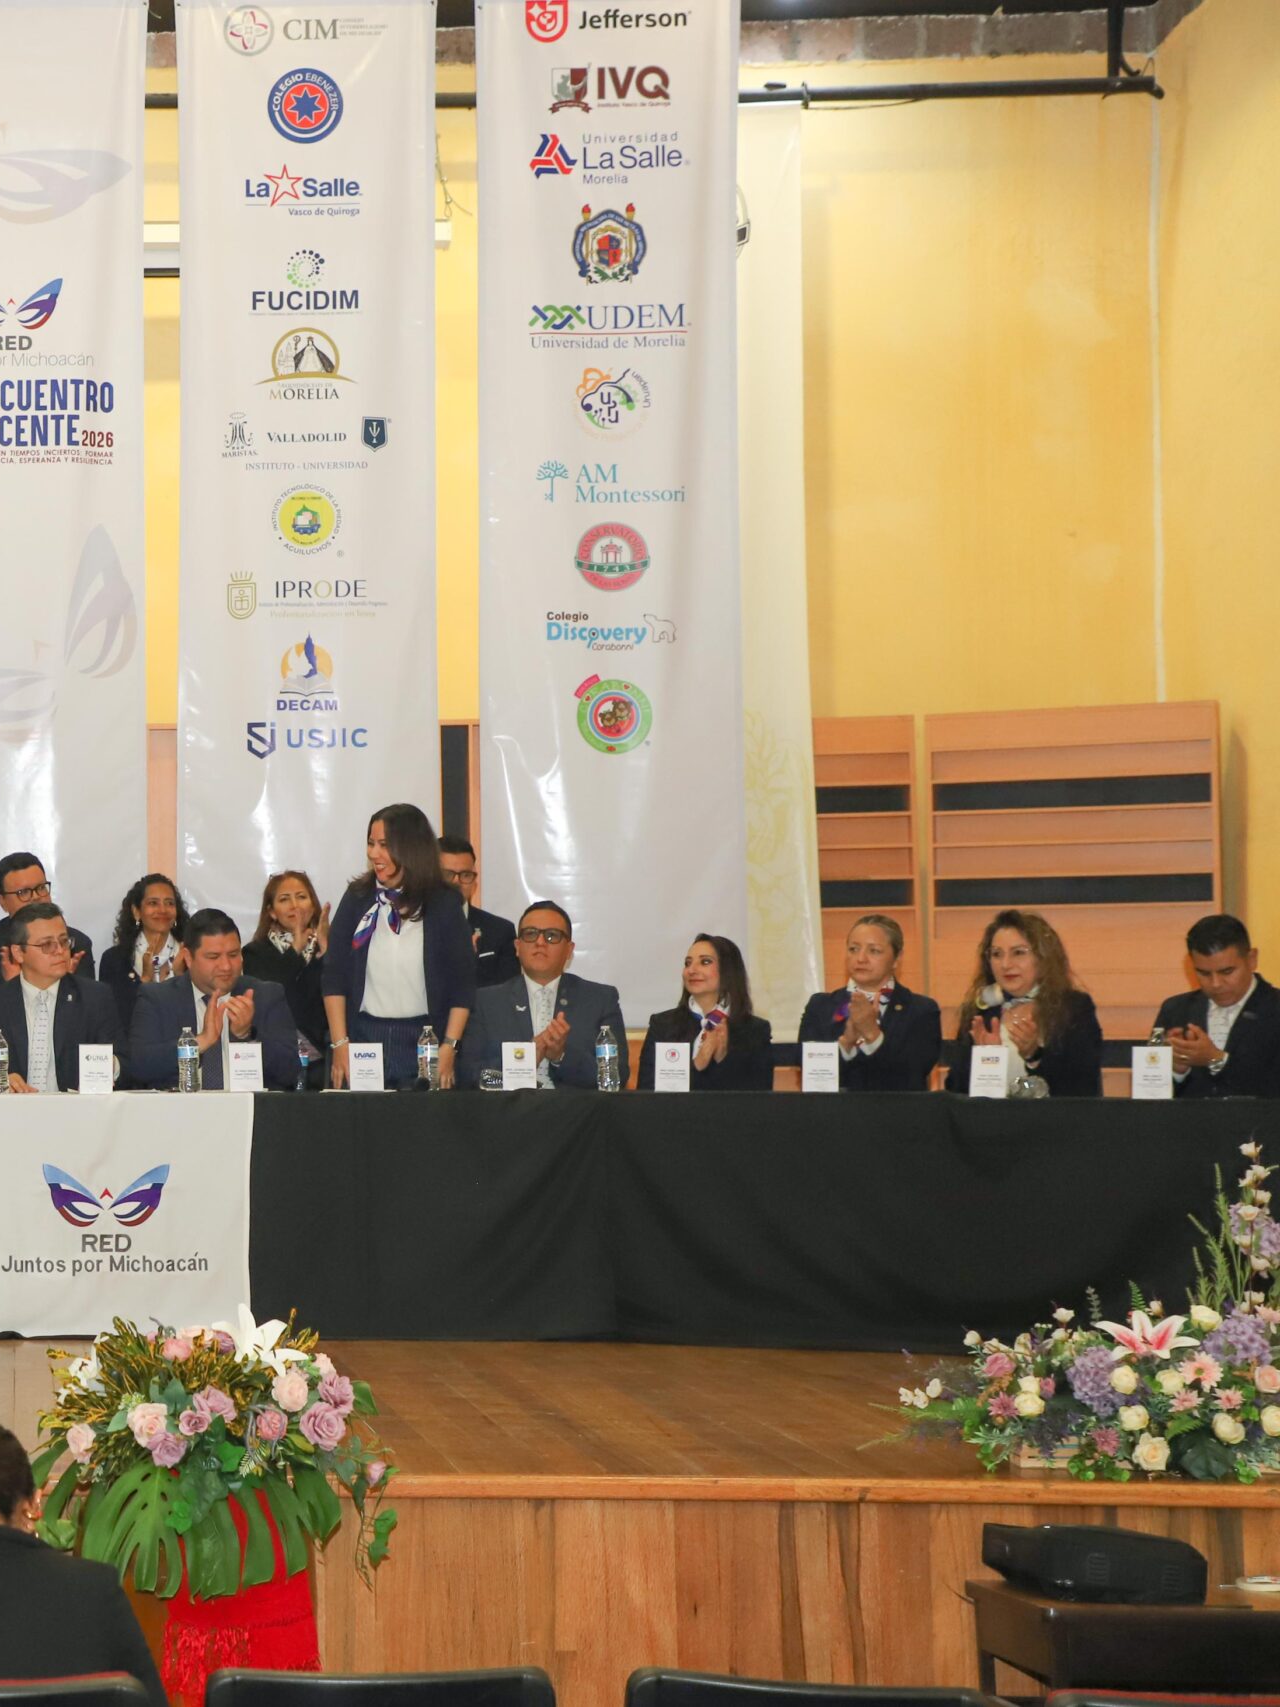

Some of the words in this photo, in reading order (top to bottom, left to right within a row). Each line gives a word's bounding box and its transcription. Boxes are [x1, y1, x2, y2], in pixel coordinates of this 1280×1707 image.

[578, 9, 687, 29] Jefferson
[282, 18, 339, 41] CIM
[272, 73, 304, 111] COLEGIO
[305, 72, 339, 111] EBENEZER
[597, 65, 670, 100] IVQ
[582, 131, 678, 144] Universidad
[245, 178, 270, 198] La
[302, 177, 360, 198] Salle
[582, 174, 628, 184] Morelia
[288, 208, 312, 216] Vasco
[314, 207, 324, 216] de
[326, 207, 360, 217] Quiroga
[252, 289, 359, 311] FUCIDIM
[587, 303, 685, 330] UDEM
[530, 335, 609, 349] Universidad
[613, 336, 629, 348] de
[633, 334, 685, 347] Morelia
[11, 352, 94, 368] Michoacán
[269, 388, 339, 400] MORELIA
[631, 370, 651, 409] Uruapan
[82, 430, 114, 447] 2026
[267, 432, 347, 443] VALLADOLID
[72, 457, 113, 465] RESILIENCIA
[85, 450, 114, 458] FORMAR
[245, 462, 295, 470] INSTITUTO
[302, 461, 368, 470] UNIVERSIDAD
[575, 463, 618, 483] AM
[575, 485, 685, 503] Montessori
[275, 579, 368, 598] IPRODE
[546, 611, 589, 622] Colegio
[546, 622, 647, 648] Discovery
[276, 699, 338, 711] DECAM
[286, 727, 368, 748] USJIC
[81, 1233, 132, 1253] RED
[1, 1255, 66, 1273] Juntos
[71, 1255, 103, 1276] por
[109, 1251, 208, 1273] Michoacán
